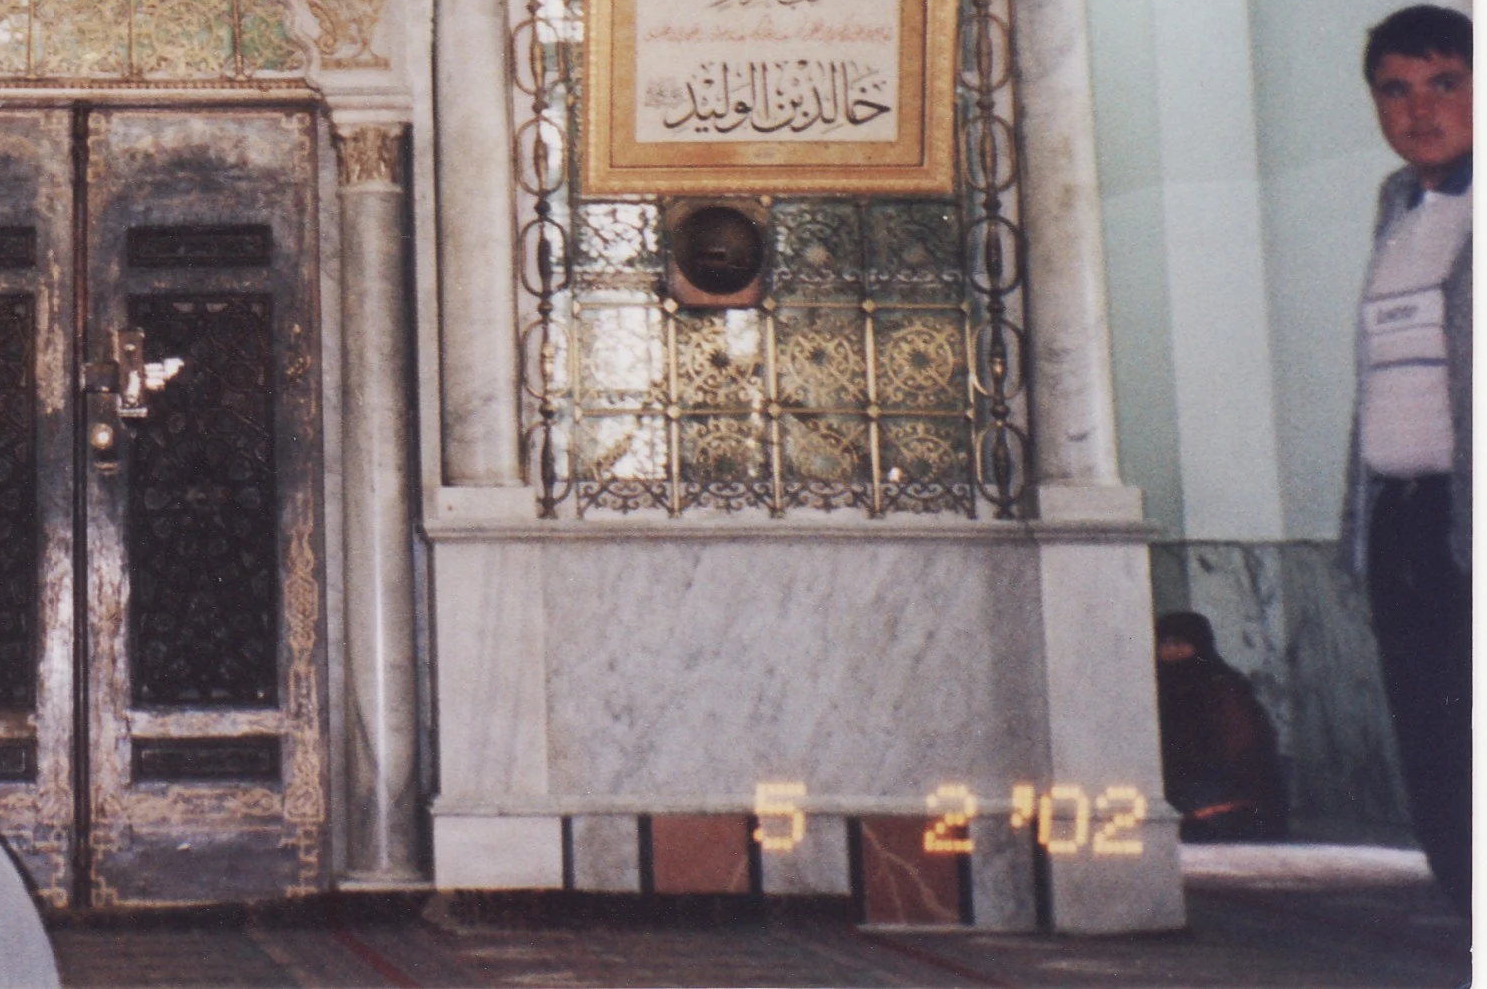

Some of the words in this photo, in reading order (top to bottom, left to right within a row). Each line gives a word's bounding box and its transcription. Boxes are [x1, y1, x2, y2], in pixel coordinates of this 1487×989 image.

[663, 61, 770, 133] الوليد
[750, 92, 812, 133] بن
[790, 61, 892, 132] خالد
